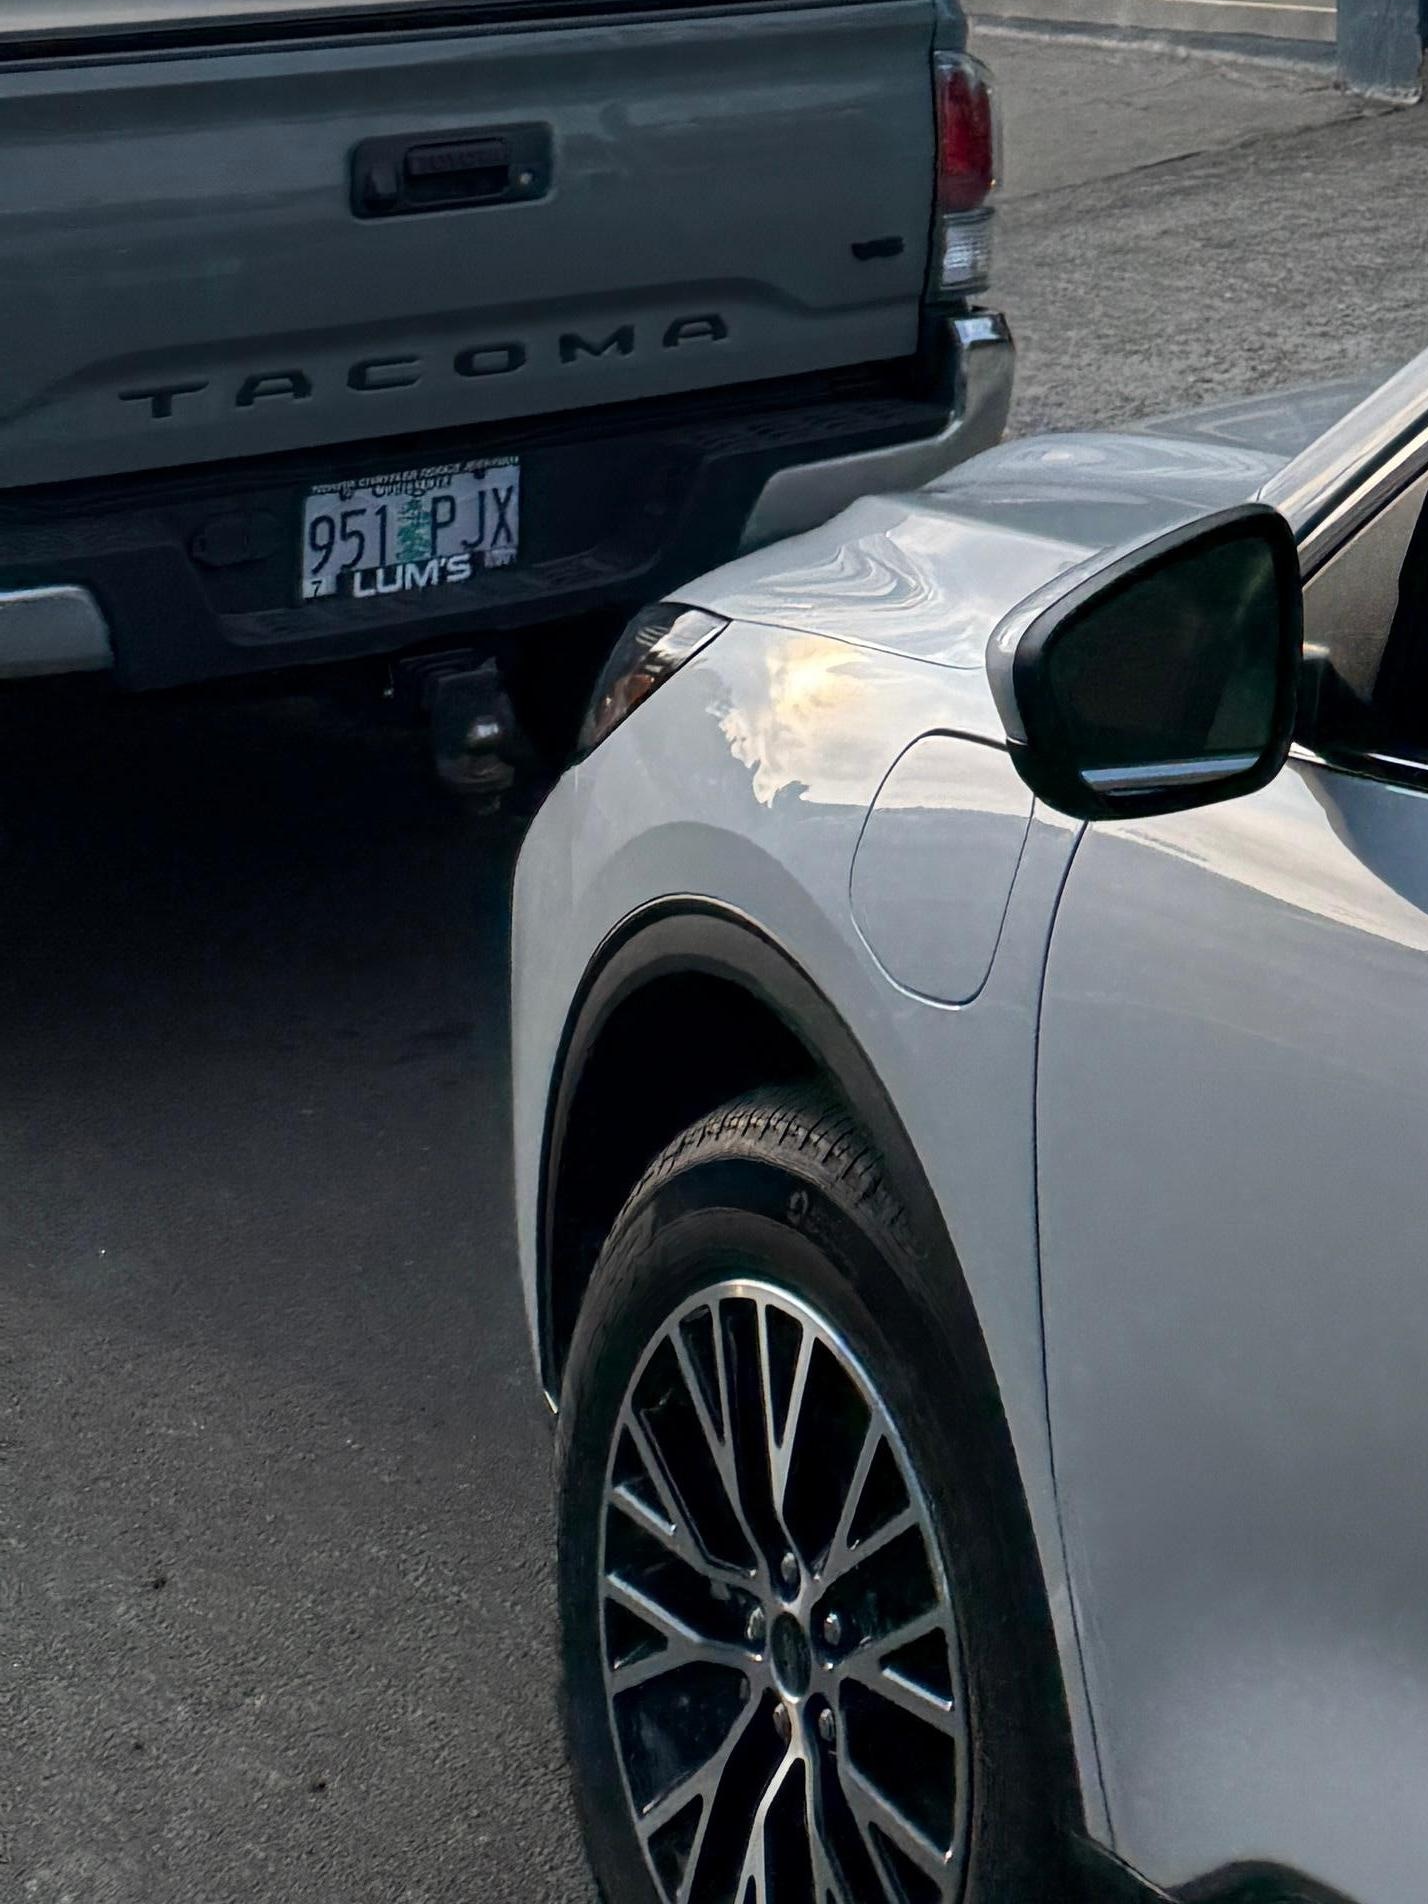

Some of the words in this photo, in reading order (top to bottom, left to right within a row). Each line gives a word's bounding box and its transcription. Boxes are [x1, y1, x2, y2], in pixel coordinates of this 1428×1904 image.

[117, 312, 729, 419] TACOMA
[308, 504, 388, 575] 951
[430, 484, 514, 556] PJX
[353, 553, 473, 598] LUM'S
